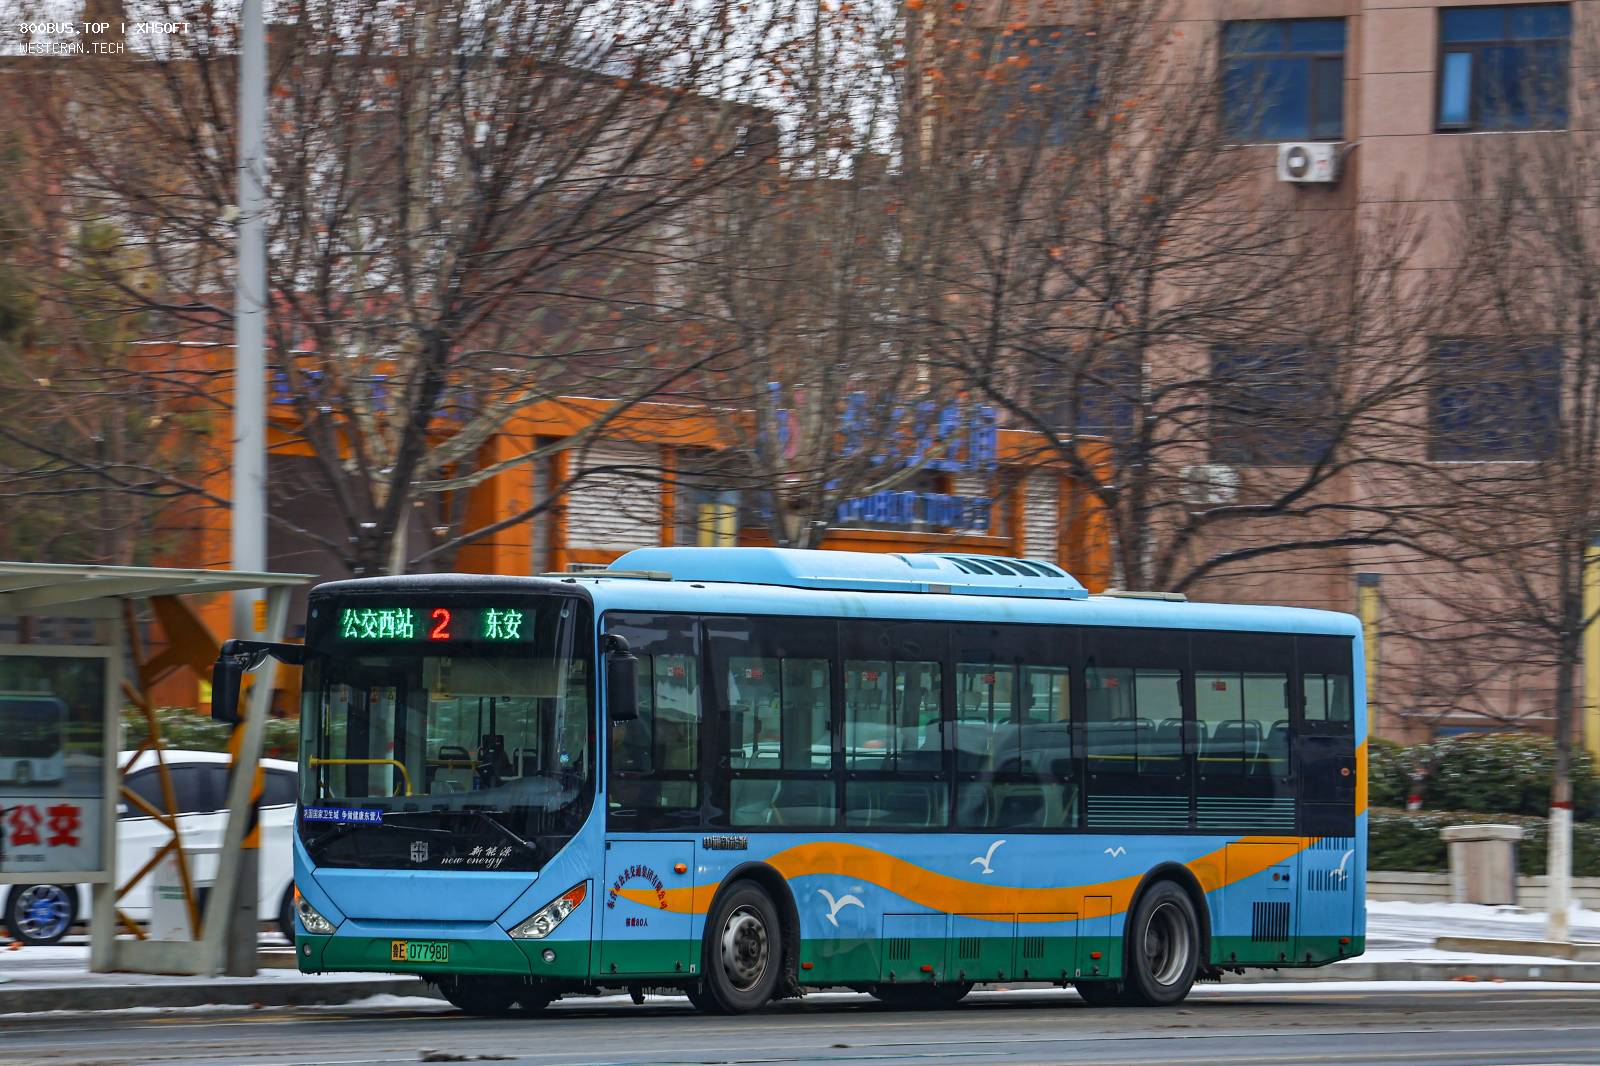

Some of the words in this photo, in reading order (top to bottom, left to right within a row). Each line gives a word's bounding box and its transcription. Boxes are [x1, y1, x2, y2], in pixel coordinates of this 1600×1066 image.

[344, 607, 414, 639] 公交西站
[432, 608, 450, 640] 2
[486, 607, 523, 640] 东安
[0, 802, 82, 847] 公交
[468, 846, 513, 857] 新能源
[466, 857, 503, 869] energy
